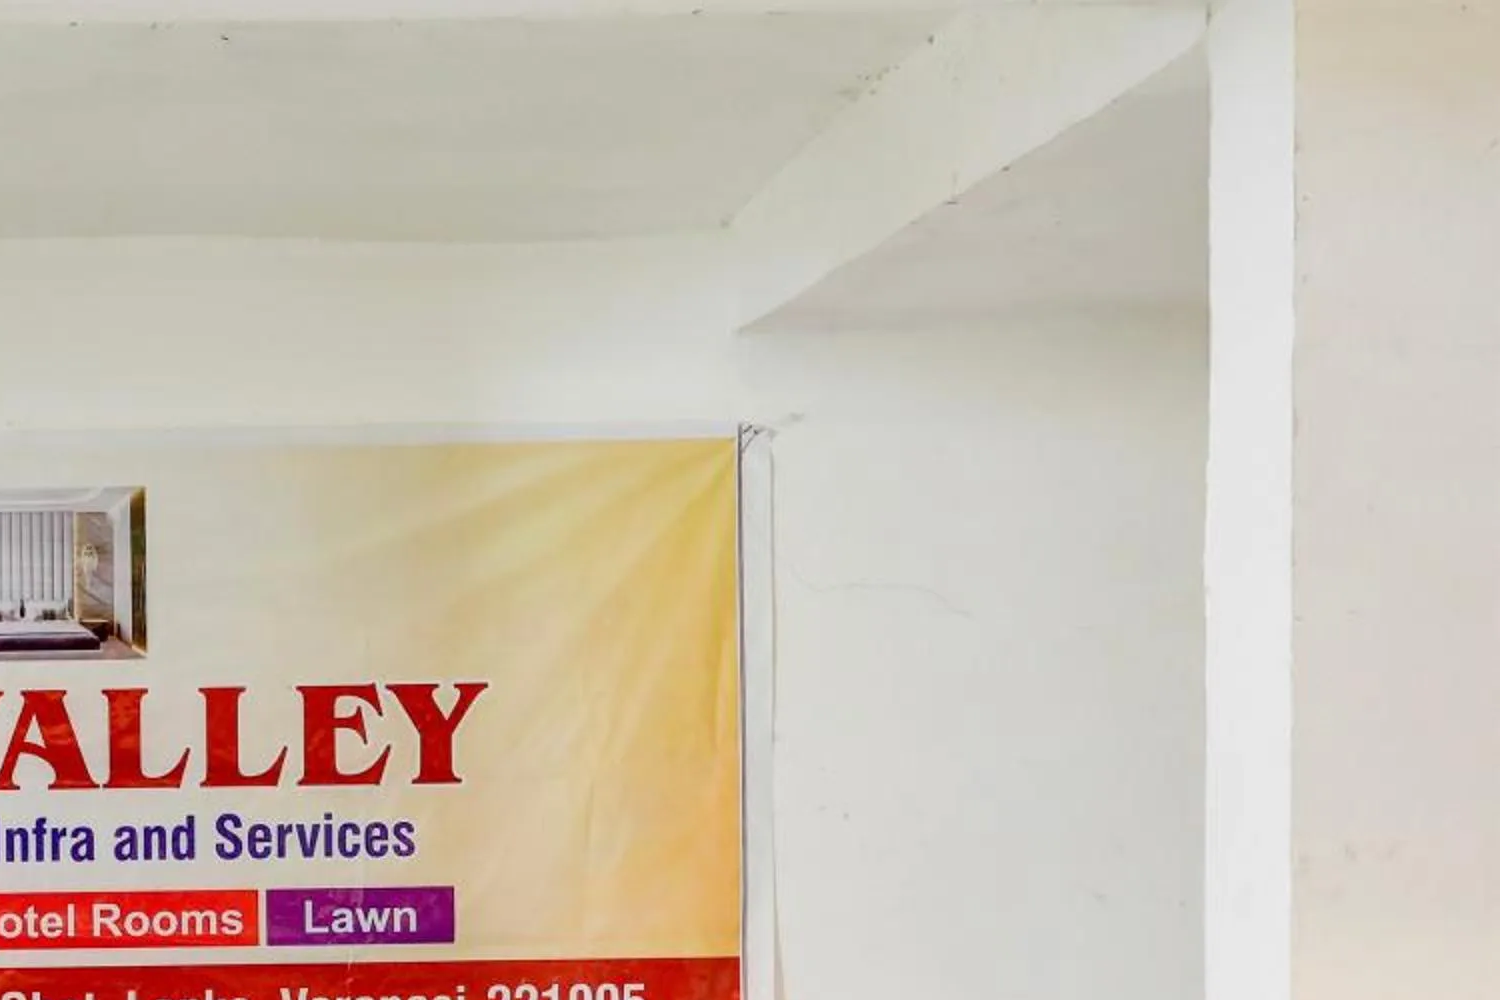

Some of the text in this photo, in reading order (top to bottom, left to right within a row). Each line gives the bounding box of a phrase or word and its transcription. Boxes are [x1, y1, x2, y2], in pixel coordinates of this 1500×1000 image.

[113, 815, 196, 861] and
[214, 810, 417, 859] Services
[93, 903, 244, 937] Rooms
[304, 900, 418, 935] Lawn
